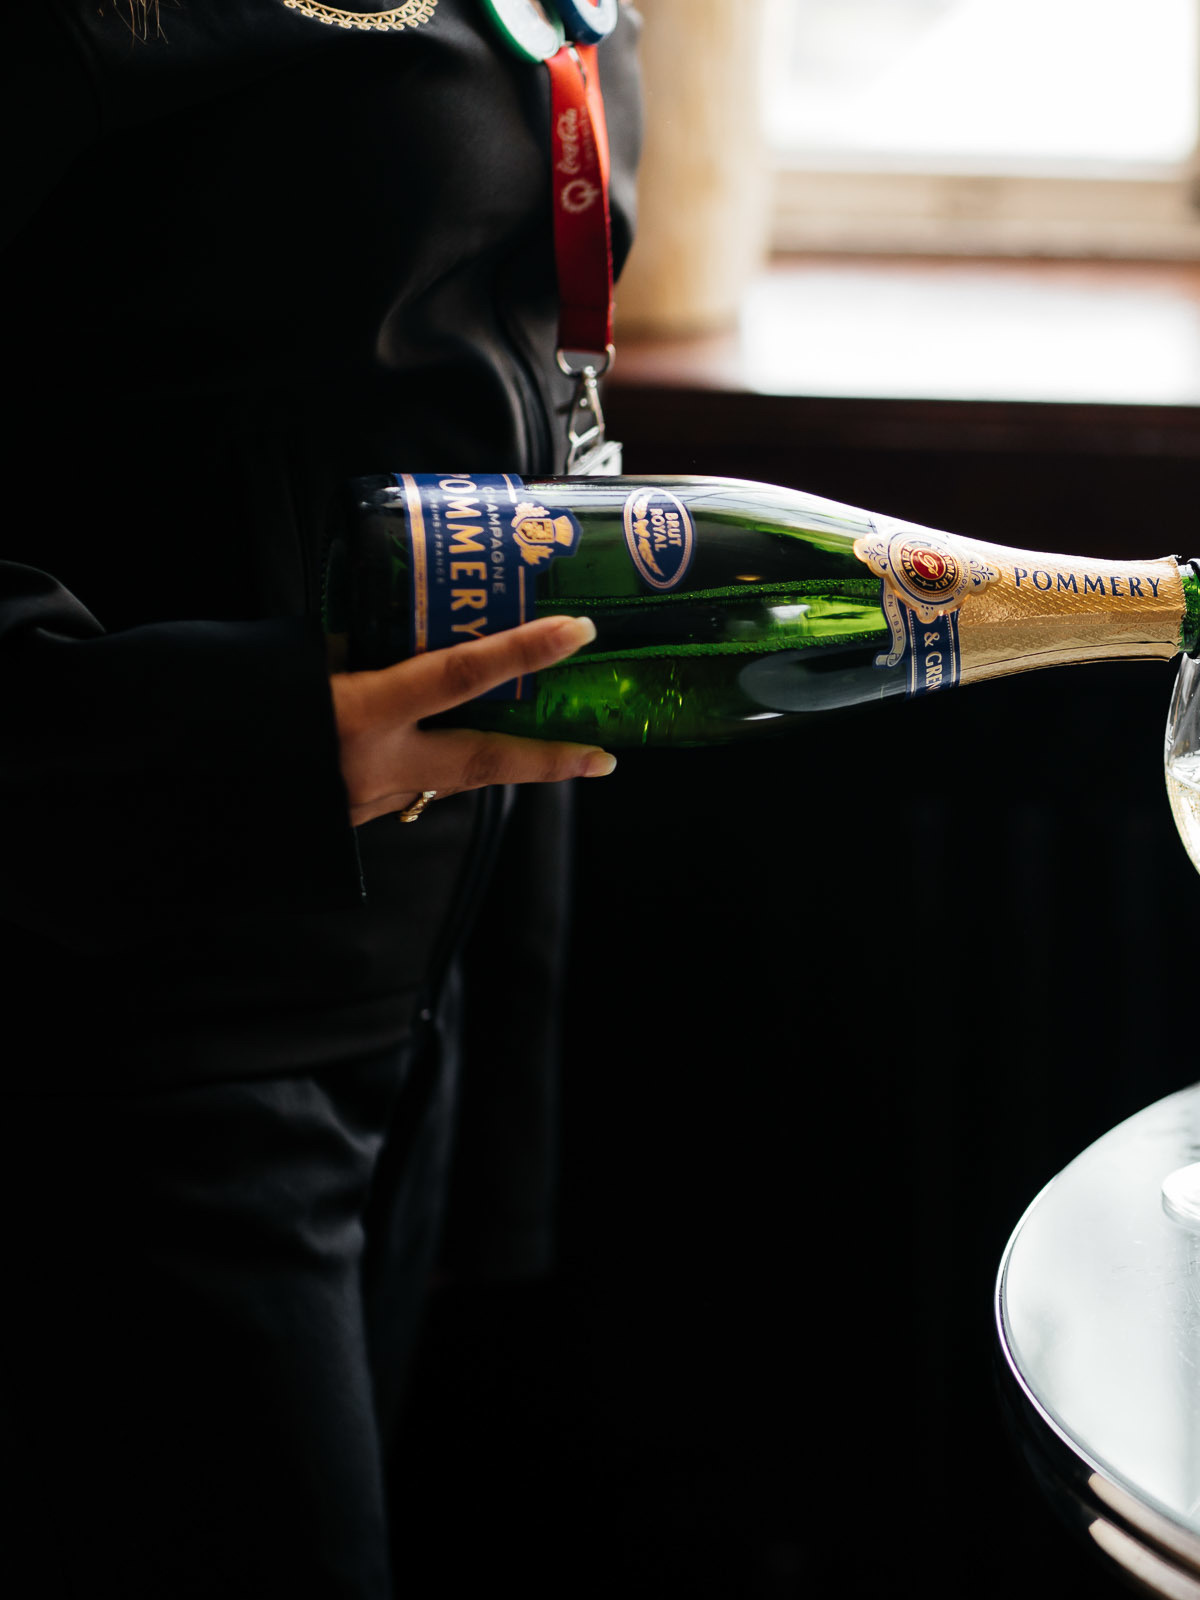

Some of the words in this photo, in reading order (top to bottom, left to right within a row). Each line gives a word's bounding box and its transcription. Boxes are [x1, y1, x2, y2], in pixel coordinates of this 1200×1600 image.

[649, 508, 668, 553] ROYAL
[664, 512, 682, 547] BRUT
[437, 474, 488, 639] OMMERY
[902, 545, 917, 577] REIMS
[935, 547, 955, 590] OMMERY
[1013, 566, 1161, 599] POMMERY
[887, 594, 894, 607] EN
[924, 632, 940, 648] &
